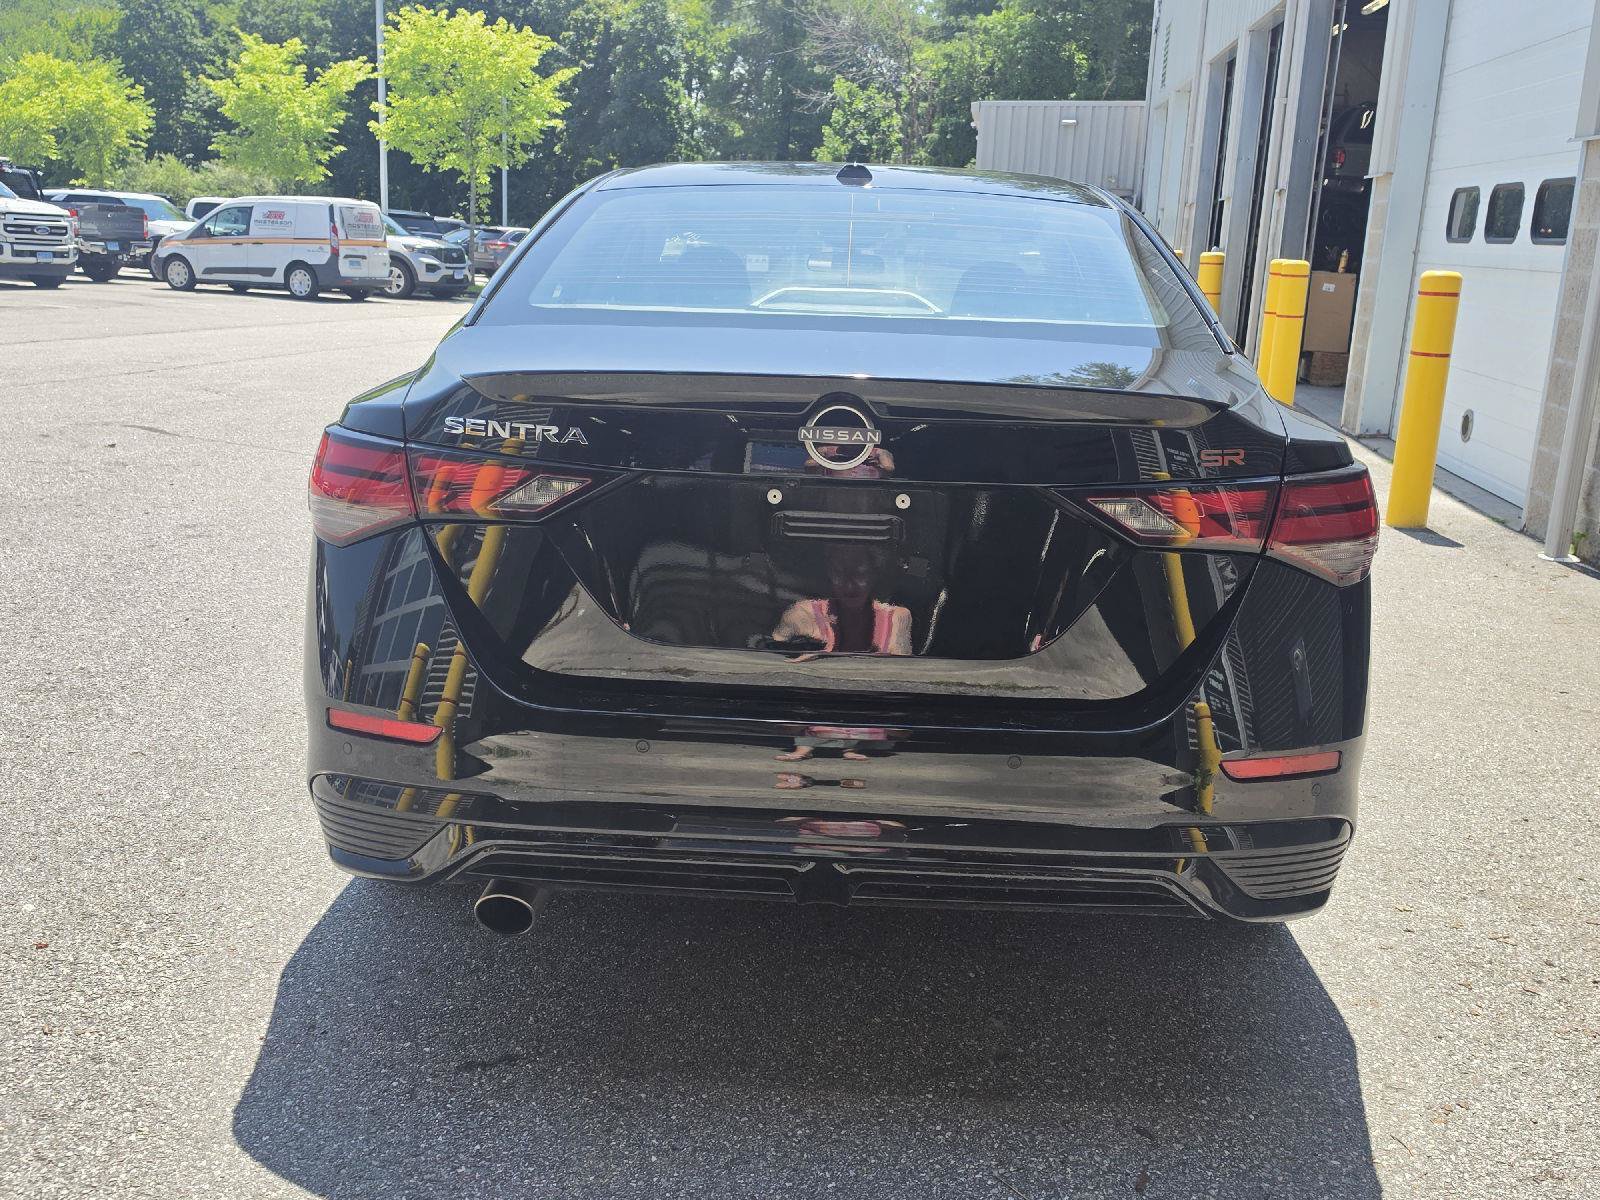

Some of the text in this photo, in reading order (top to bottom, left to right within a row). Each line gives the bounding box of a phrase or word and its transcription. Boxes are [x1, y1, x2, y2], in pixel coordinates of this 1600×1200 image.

[443, 416, 588, 445] SENTRA
[800, 428, 879, 442] NISSAN
[1200, 448, 1245, 467] SR
